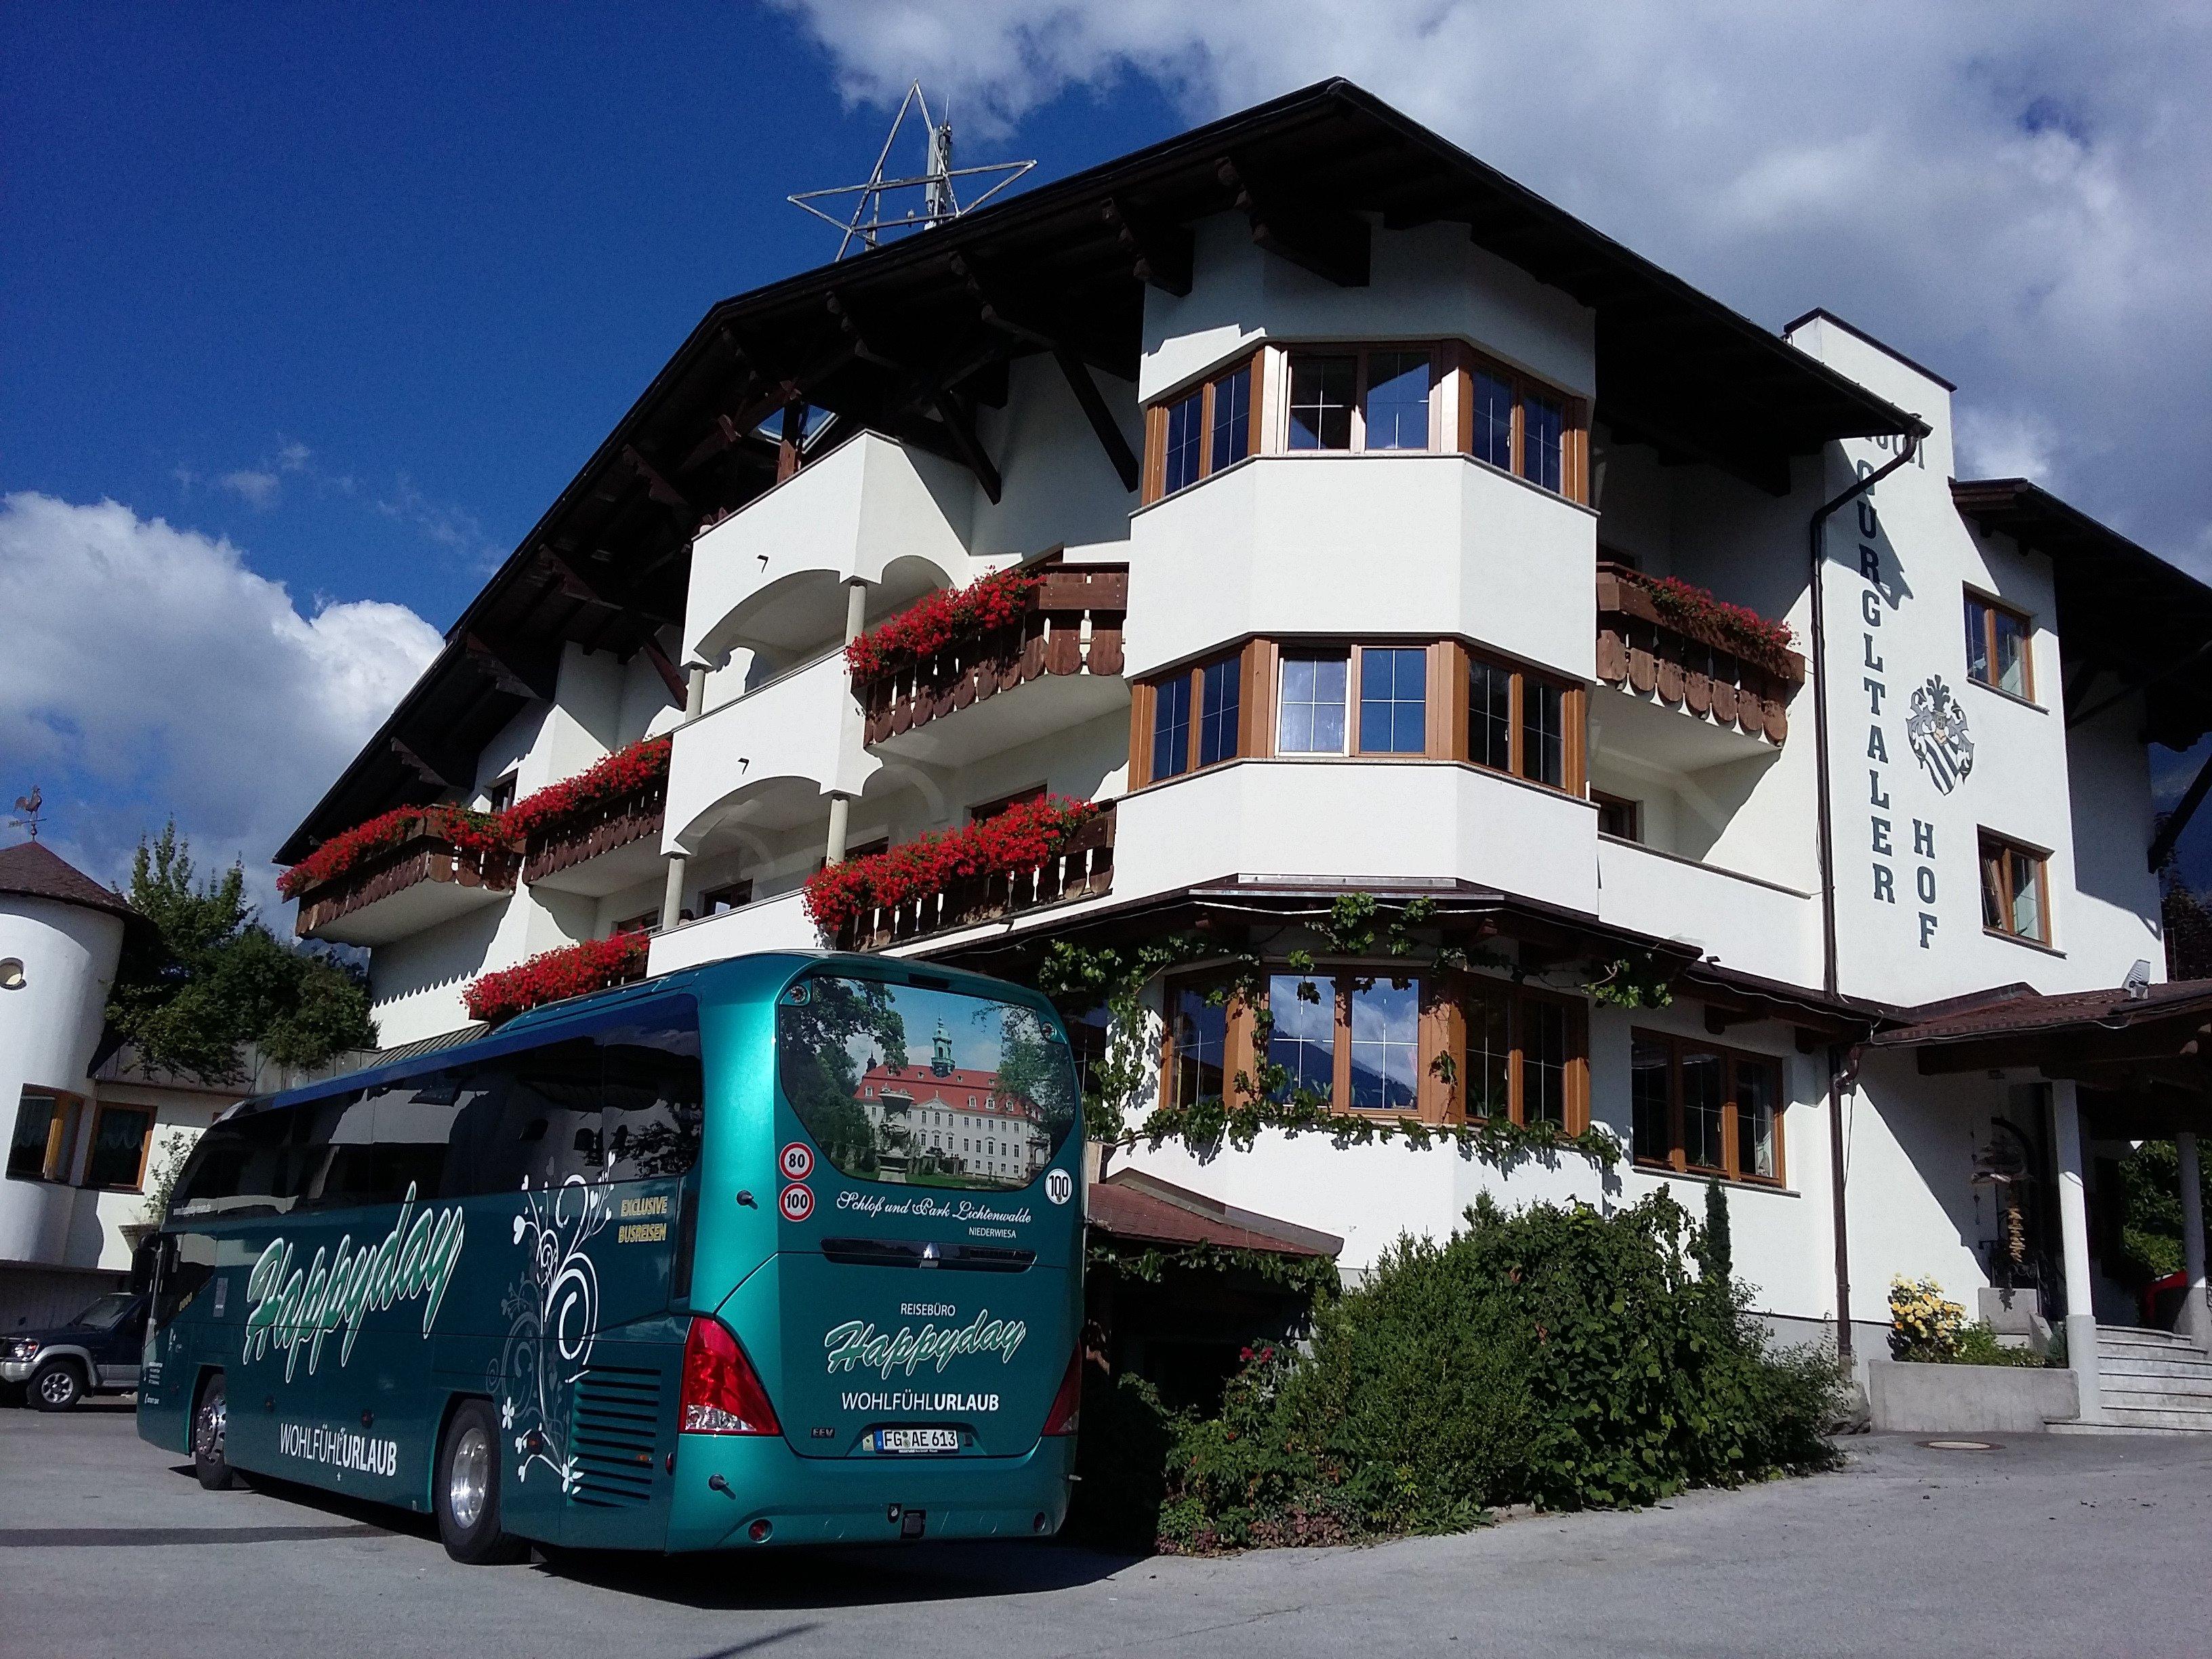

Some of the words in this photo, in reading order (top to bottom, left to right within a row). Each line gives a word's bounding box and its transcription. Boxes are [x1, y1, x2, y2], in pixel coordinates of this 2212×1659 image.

[1912, 817, 1938, 950] HOF
[788, 1153, 805, 1169] 80
[1050, 1174, 1069, 1197] 100
[621, 1195, 668, 1216] EXCLUSIVE
[786, 1193, 808, 1209] 100
[836, 1191, 884, 1218] Schloß
[884, 1199, 909, 1214] und
[912, 1197, 950, 1217] Park
[951, 1200, 1031, 1223] Lichtenwalde
[618, 1223, 667, 1244] BUSREISEN
[968, 1227, 1017, 1239] NIEDERWIESA
[243, 1180, 465, 1384] Happyday
[901, 1302, 956, 1317] REISEBÜRO
[824, 1309, 1026, 1380] Happyday
[842, 1389, 1000, 1411] WOHLFÜHLURLAUB
[813, 1428, 834, 1437] EEV
[884, 1431, 902, 1447] FG
[912, 1431, 929, 1447] AE
[931, 1431, 956, 1447] 613
[279, 1422, 397, 1477] WOHLFÜHLURLAUB
